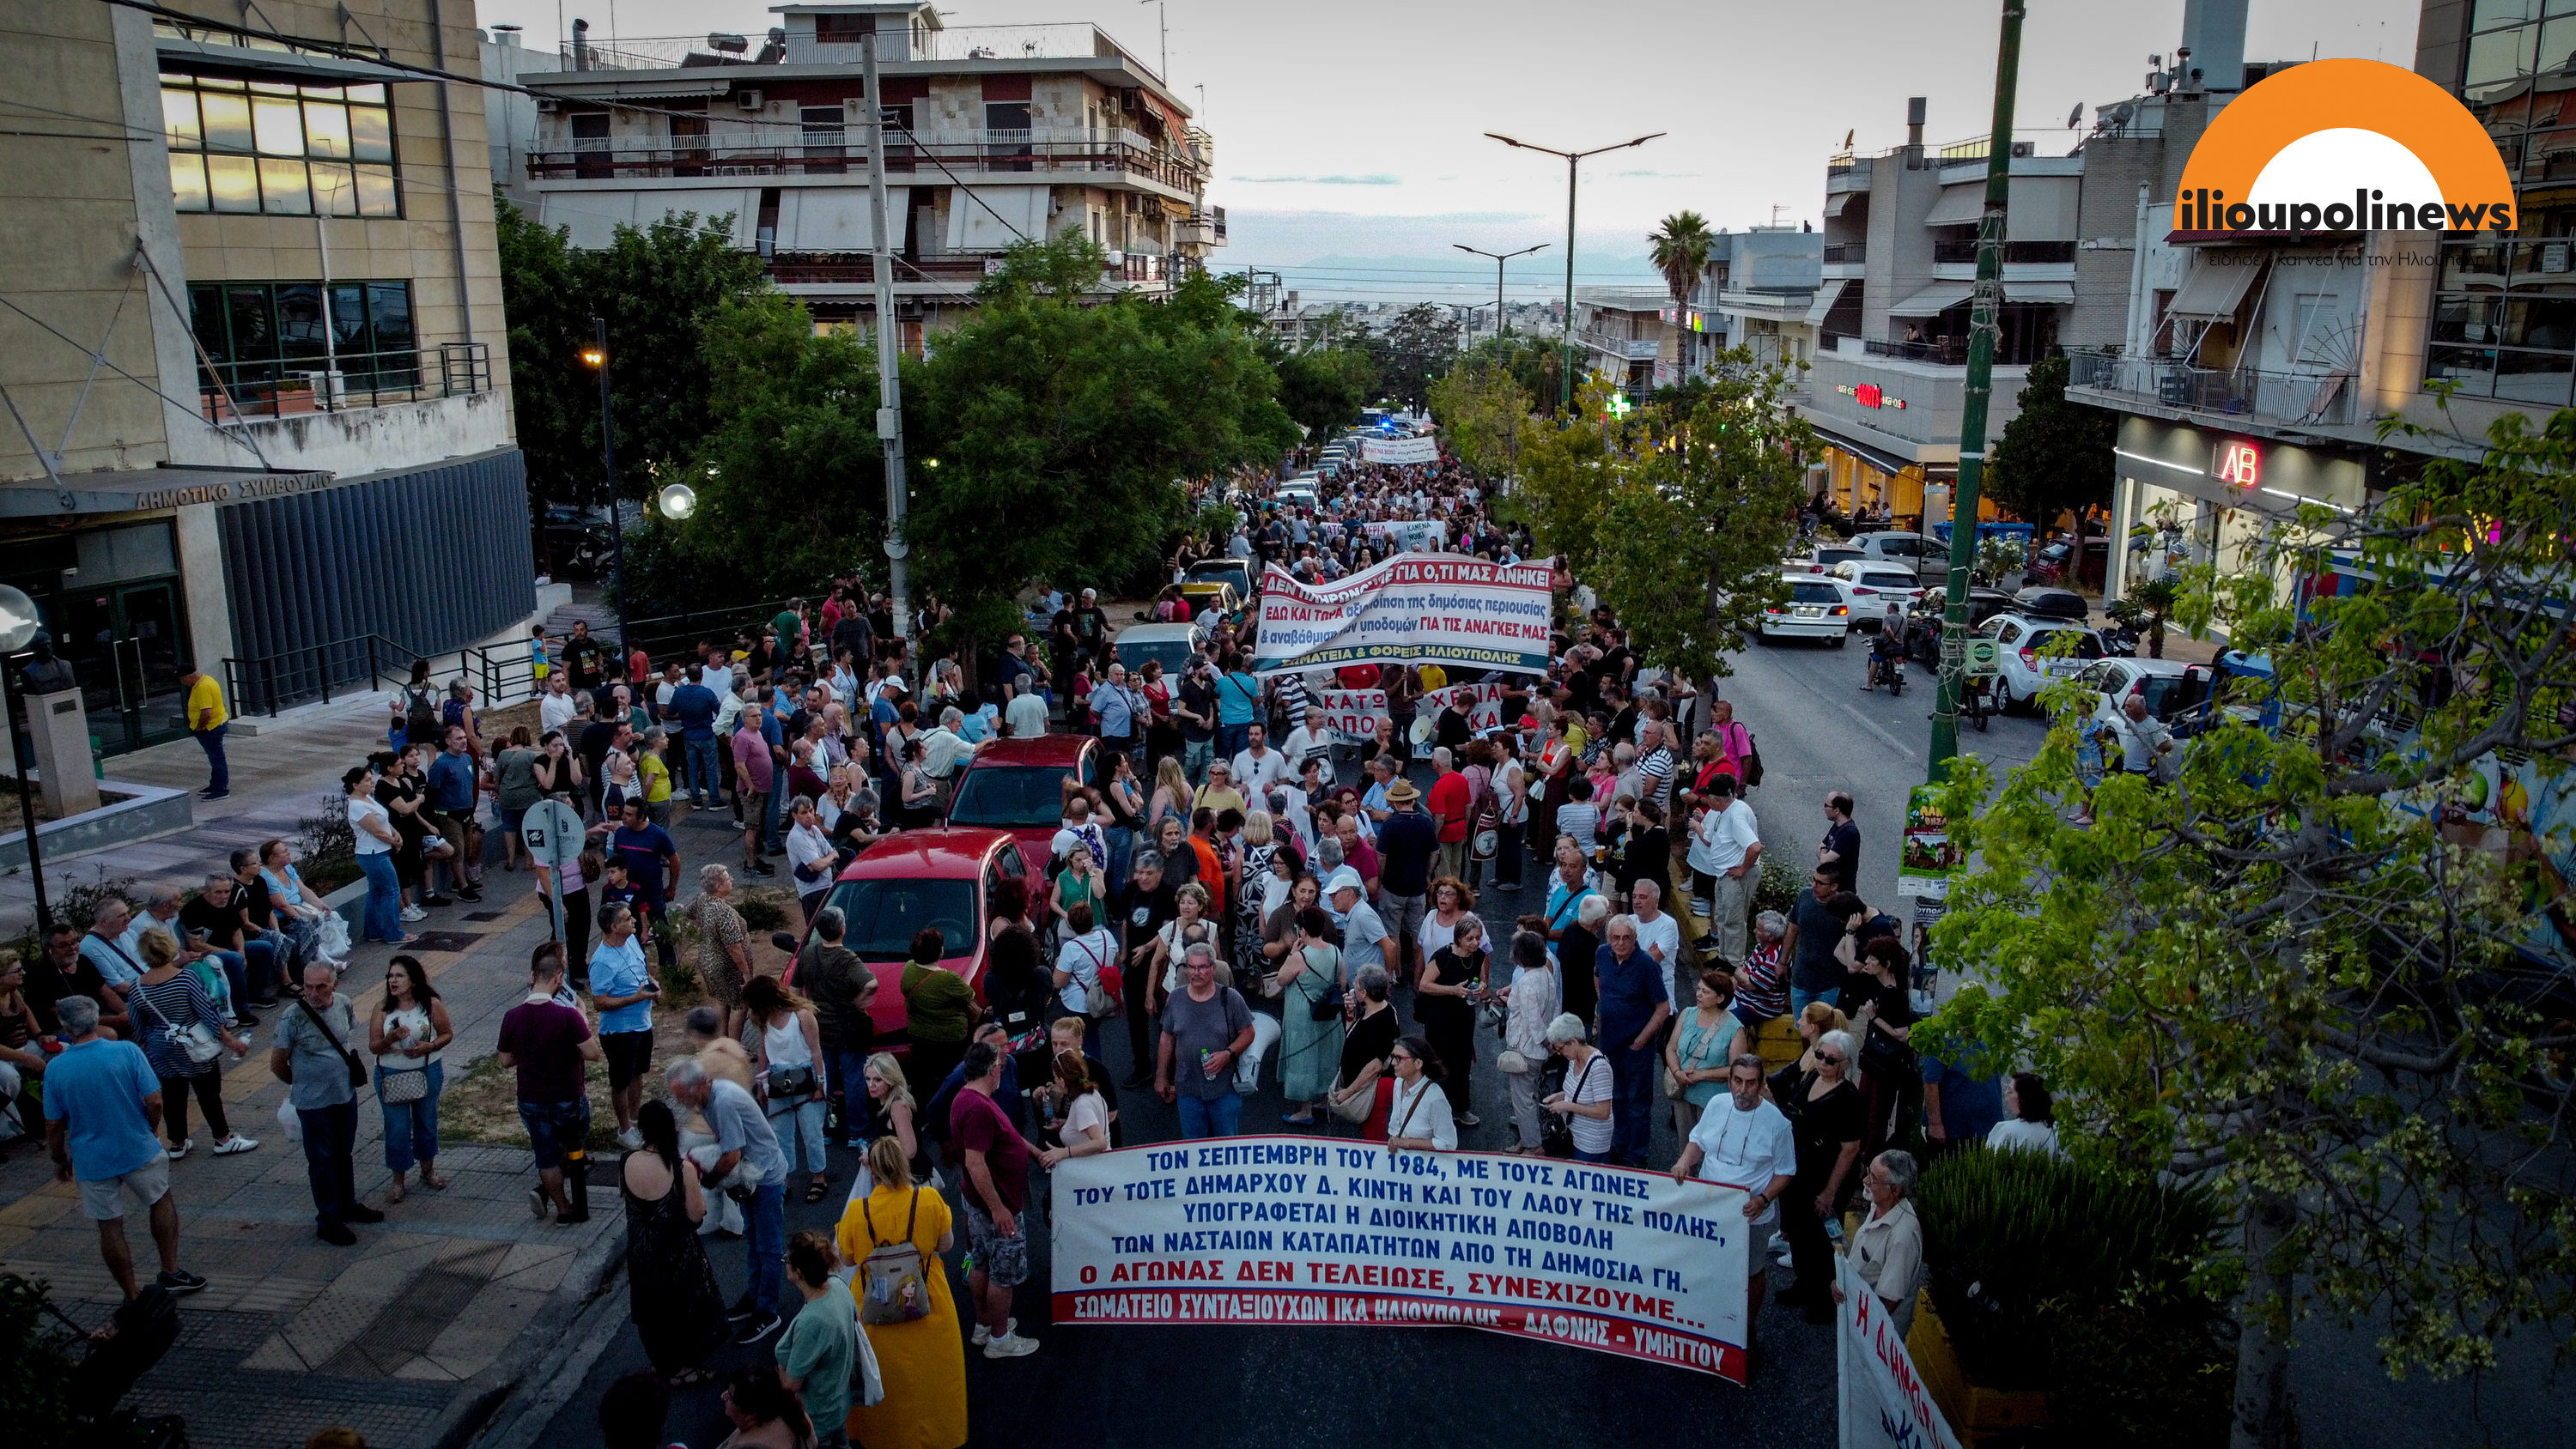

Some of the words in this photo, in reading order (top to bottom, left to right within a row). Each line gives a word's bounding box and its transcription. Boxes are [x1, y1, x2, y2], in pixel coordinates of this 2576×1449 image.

[136, 483, 231, 511] ΔΗΜΟΤΙΚΟ
[1266, 575, 1297, 597] ΔΕΝ
[1395, 564, 1419, 580] ΓΙΑ
[1457, 565, 1492, 582] ΜΑΣ
[1494, 567, 1550, 587] ΑΝΗΚΕΙ
[1266, 606, 1288, 621] ΕΔΩ
[1291, 606, 1311, 621] ΚΑΙ
[1315, 606, 1344, 621] ΤΩΡΑ
[1406, 595, 1425, 610] της
[1428, 593, 1482, 612] δημόσιας
[1485, 599, 1546, 620] περιουσίας
[1261, 629, 1268, 644] &
[1359, 616, 1419, 634] υποδομών
[1419, 616, 1440, 631] ΓΙΑ
[1442, 616, 1461, 633] ΤΙΣ
[1464, 618, 1519, 638] ΑΝΑΓΚΕΣ
[1522, 624, 1547, 641] ΜΑΣ
[1356, 646, 1366, 658] &
[1369, 645, 1422, 658] ΦΟΡΕΙΣ
[1425, 646, 1522, 665] ΗΛΙΟΥΠΟΛΗΣ
[1324, 694, 1385, 710] ΚΑΤΩ
[1431, 684, 1501, 708] ΧΕΙΑ
[1327, 714, 1376, 734] ΑΠΟ
[1147, 1149, 1189, 1172] ΤΟΝ
[1198, 1144, 1327, 1167] ΣΕΠΤΕΜΒΡΗ
[1336, 1149, 1376, 1171] ΤΟΥ
[1388, 1154, 1447, 1182] 1984,
[1457, 1159, 1488, 1180] ΜΕ
[1498, 1161, 1553, 1185] ΤΟΥΣ
[1564, 1169, 1649, 1200] ΑΓΩΝΕΣ
[1073, 1185, 1115, 1206] ΤΟΥ
[1124, 1178, 1176, 1201] ΤΟΤΕ
[1185, 1173, 1308, 1196] ΔΗΜΑΡΧΟΥ
[1315, 1175, 1339, 1196] Δ.
[1348, 1177, 1413, 1203] ΚΙΝΤΗ
[1422, 1185, 1461, 1205] ΚΑΙ
[1470, 1187, 1513, 1210] ΤΟΥ
[1522, 1192, 1583, 1217] ΛΑΟΥ
[1592, 1200, 1635, 1225] ΤΗΣ
[1643, 1210, 1726, 1247] ΠΟΛΗΣ,
[1182, 1201, 1336, 1224] ΥΠΟΓΡΑΦΕΤΑΙ
[1346, 1205, 1360, 1226] Η
[1370, 1207, 1497, 1236] ΔΙΟΙΚΗΤΙΚΗ
[1506, 1218, 1613, 1251] ΑΠΟΒΟΛΗ
[1111, 1234, 1154, 1254] ΤΩΝ
[1163, 1229, 1273, 1252] ΝΑΣΤΑΙΩΝ
[1282, 1230, 1440, 1260] ΚΑΤΑΠΑΤΗΤΩΝ
[1449, 1241, 1495, 1264] ΑΠΟ
[1504, 1246, 1532, 1269] ΤΗ
[1541, 1250, 1643, 1285] ΔΗΜΟΣΙΑ
[1653, 1268, 1689, 1294] ΓΗ.
[1079, 1264, 1097, 1285] Ο
[1110, 1259, 1224, 1283] ΑΓΩΝΑΣ
[1236, 1261, 1294, 1282] ΔΕΝ
[1306, 1262, 1455, 1296] ΤΕΛΕΙΩΣΕ,
[1467, 1271, 1705, 1330] ΣΥΝΕΧΙΖΟΥΜΕ...
[1074, 1292, 1173, 1319] ΣΩΜΑΤΕΙΟ
[1179, 1293, 1327, 1321] ΣΥΝΤΑΞΙΟΥΧΩΝ
[1334, 1296, 1369, 1322] ΙΚΑ
[1375, 1299, 1502, 1327] ΗΛΙΟΥΠΟΛΗΣ
[1524, 1313, 1610, 1346] ΔΑΦΝΗΣ
[1632, 1325, 1725, 1372] ΥΜΗΤΤΟΥ
